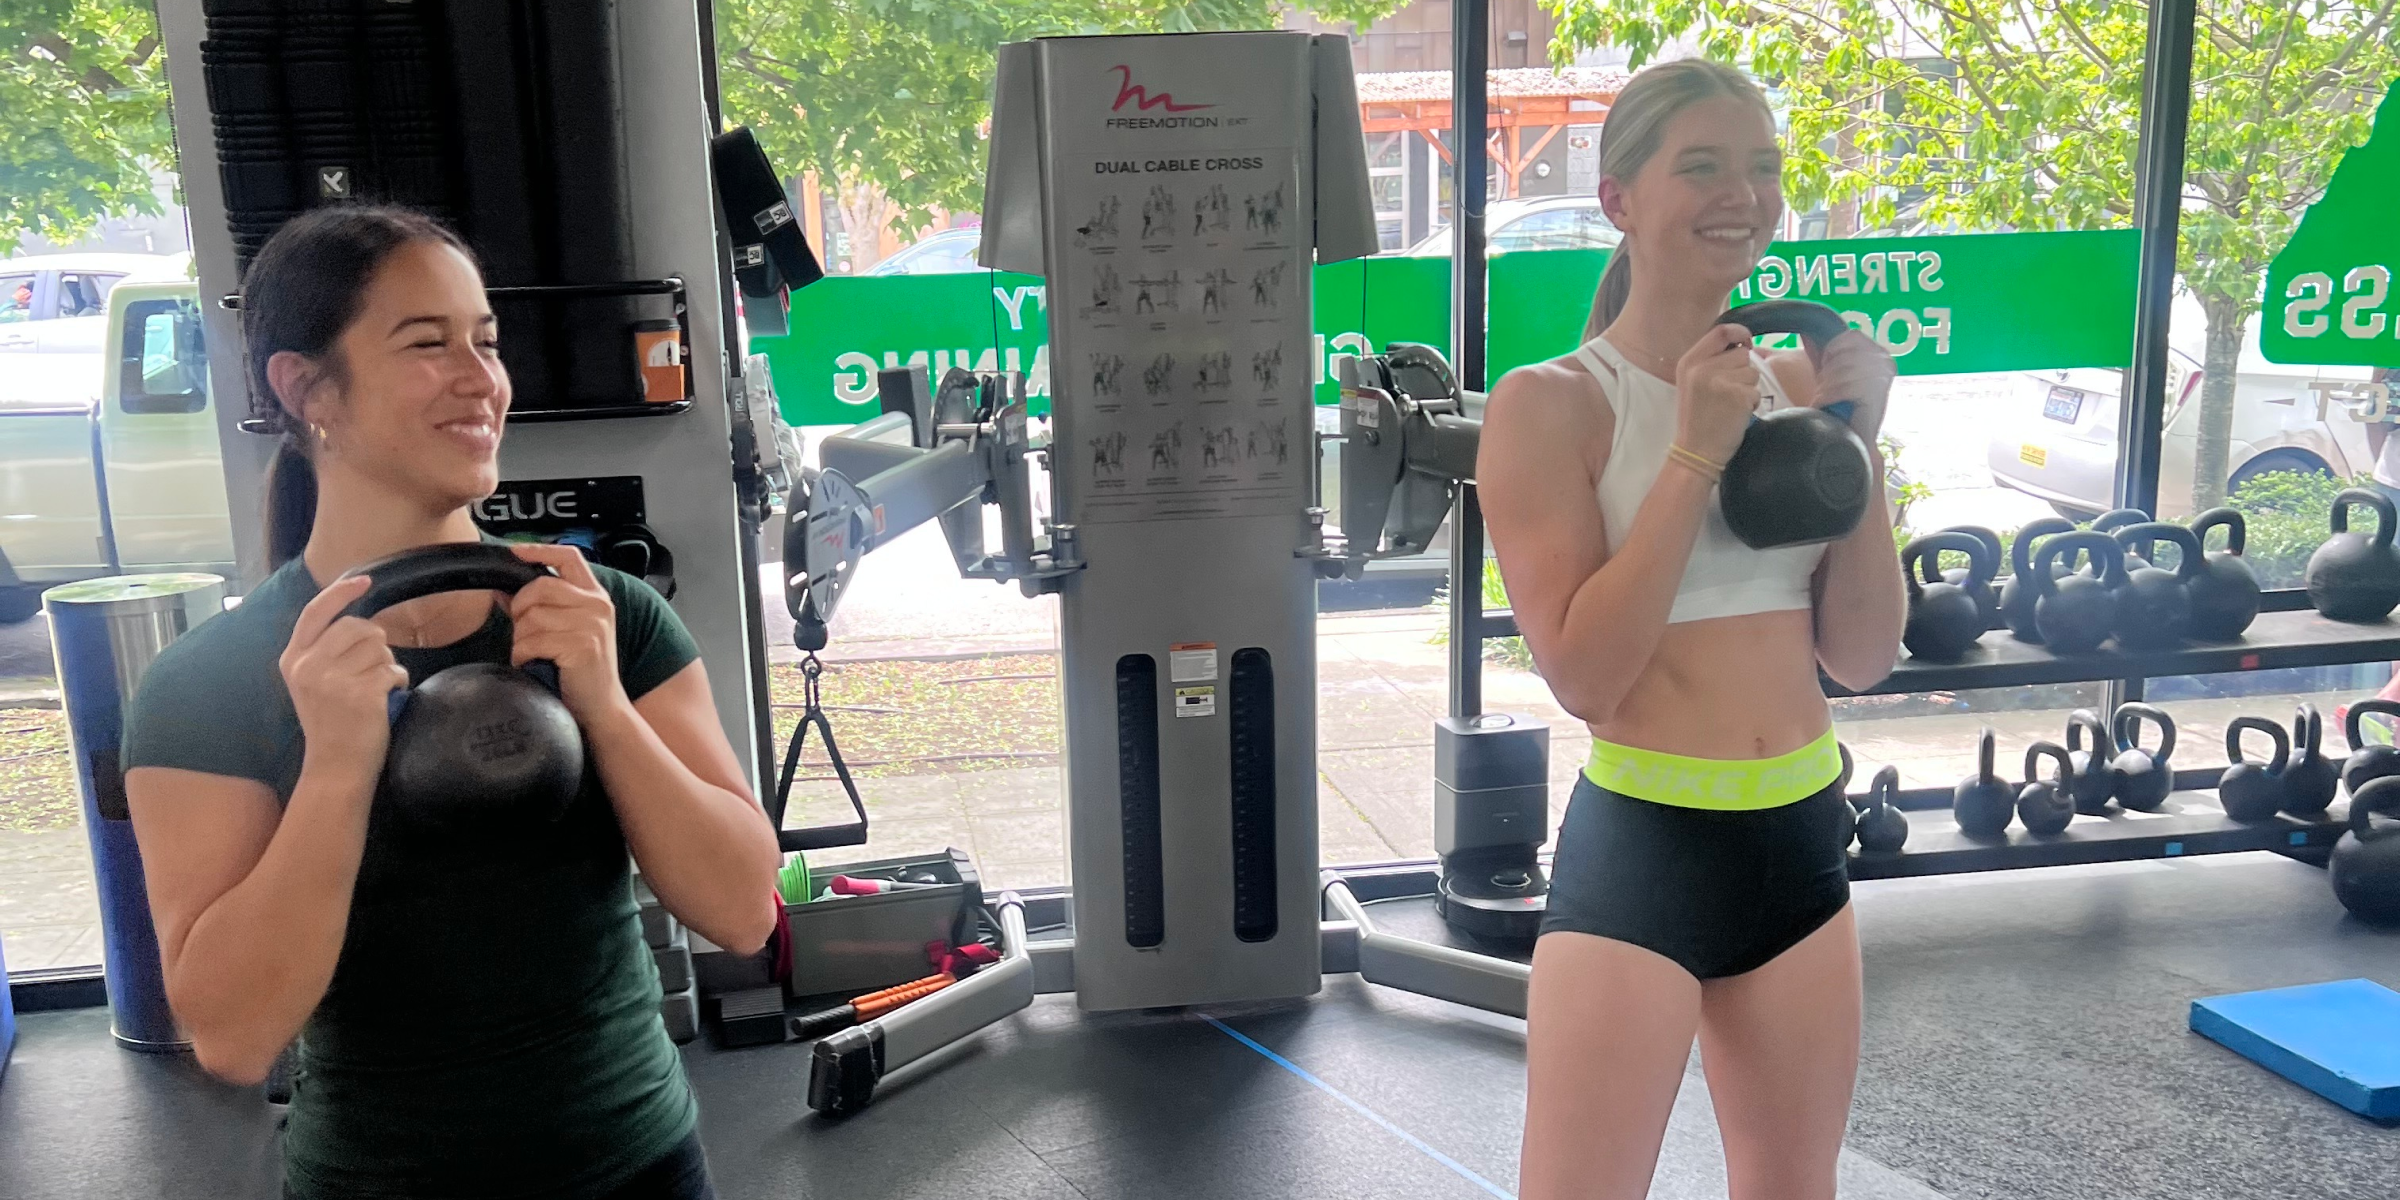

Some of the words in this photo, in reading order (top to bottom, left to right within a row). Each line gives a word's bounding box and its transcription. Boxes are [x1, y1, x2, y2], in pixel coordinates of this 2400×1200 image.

[1106, 117, 1218, 129] FREEMOTION
[1095, 161, 1141, 174] DUAL
[1144, 159, 1200, 173] CABLE
[1205, 157, 1264, 172] CROSS
[1611, 757, 1747, 800] NIKE
